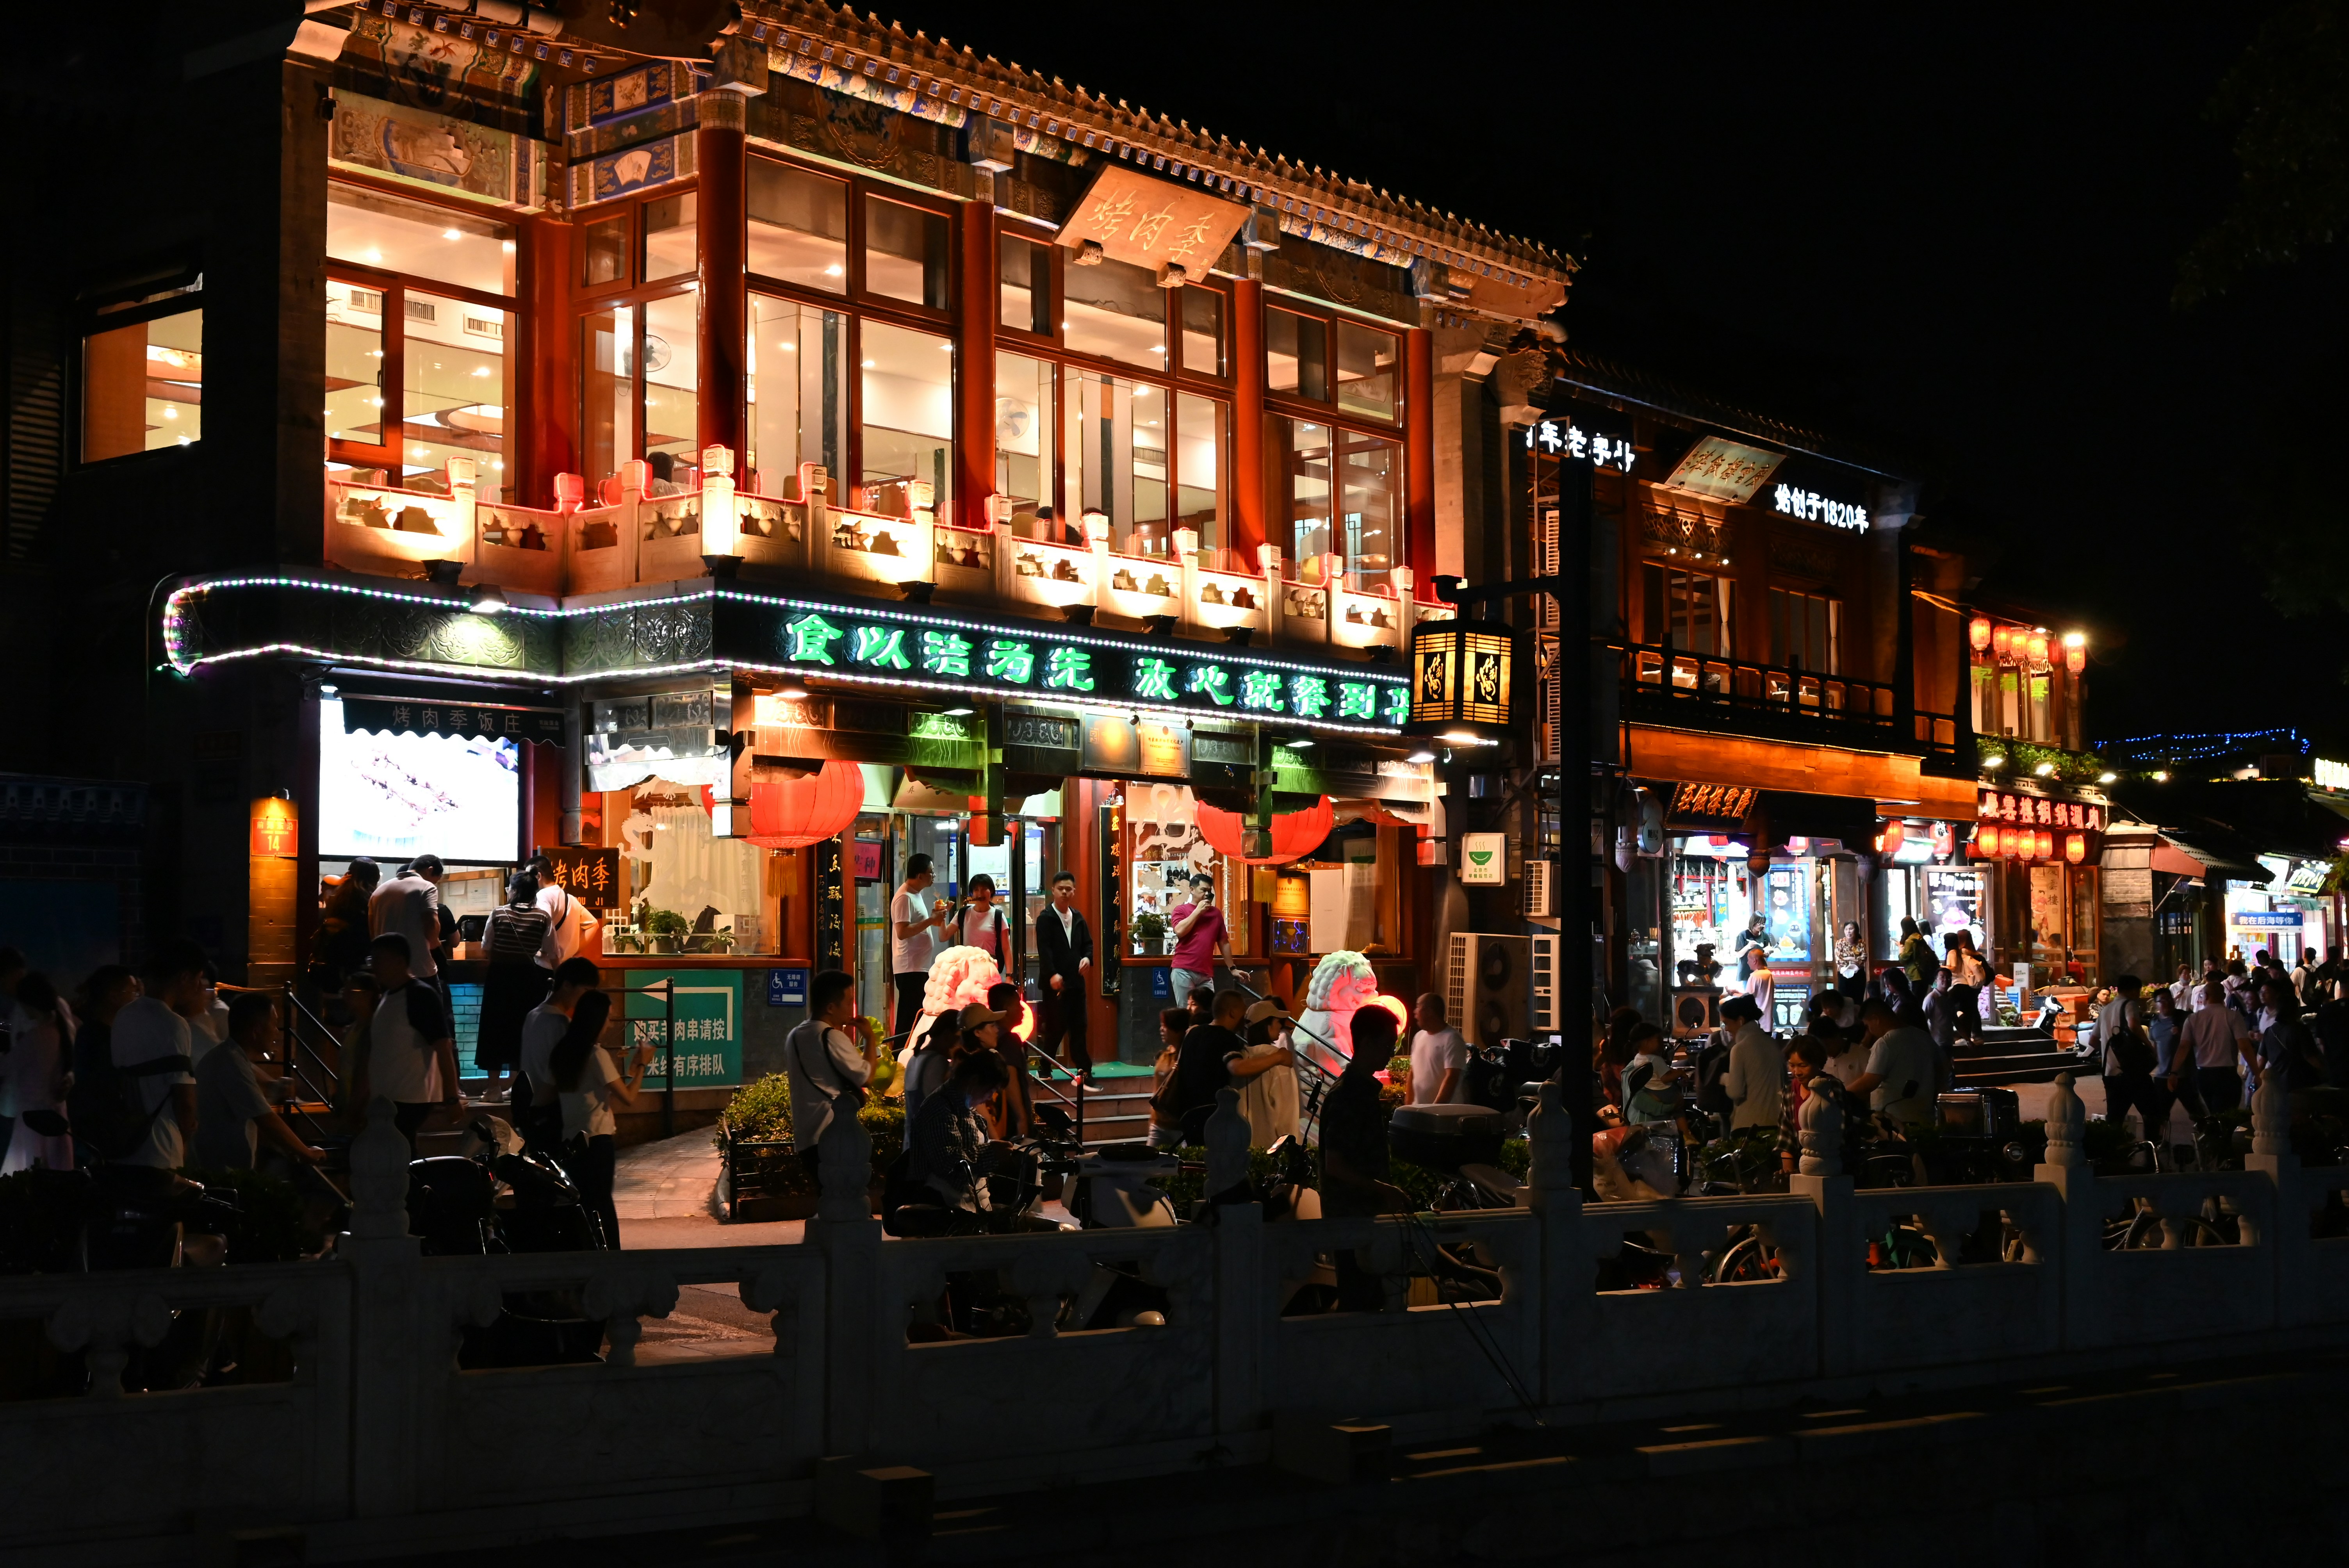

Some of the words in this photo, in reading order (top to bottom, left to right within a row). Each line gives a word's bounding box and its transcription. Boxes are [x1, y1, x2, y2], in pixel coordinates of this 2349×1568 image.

[1087, 190, 1215, 262] 烤肉季
[1775, 484, 1869, 534] 始创于1820年
[786, 614, 1094, 691] 食以洁为先
[392, 705, 521, 733] 烤肉季饭庄
[267, 835, 280, 851] 14
[576, 896, 586, 905] OU
[595, 897, 603, 906] JI
[2239, 916, 2294, 925] 我在后海等你
